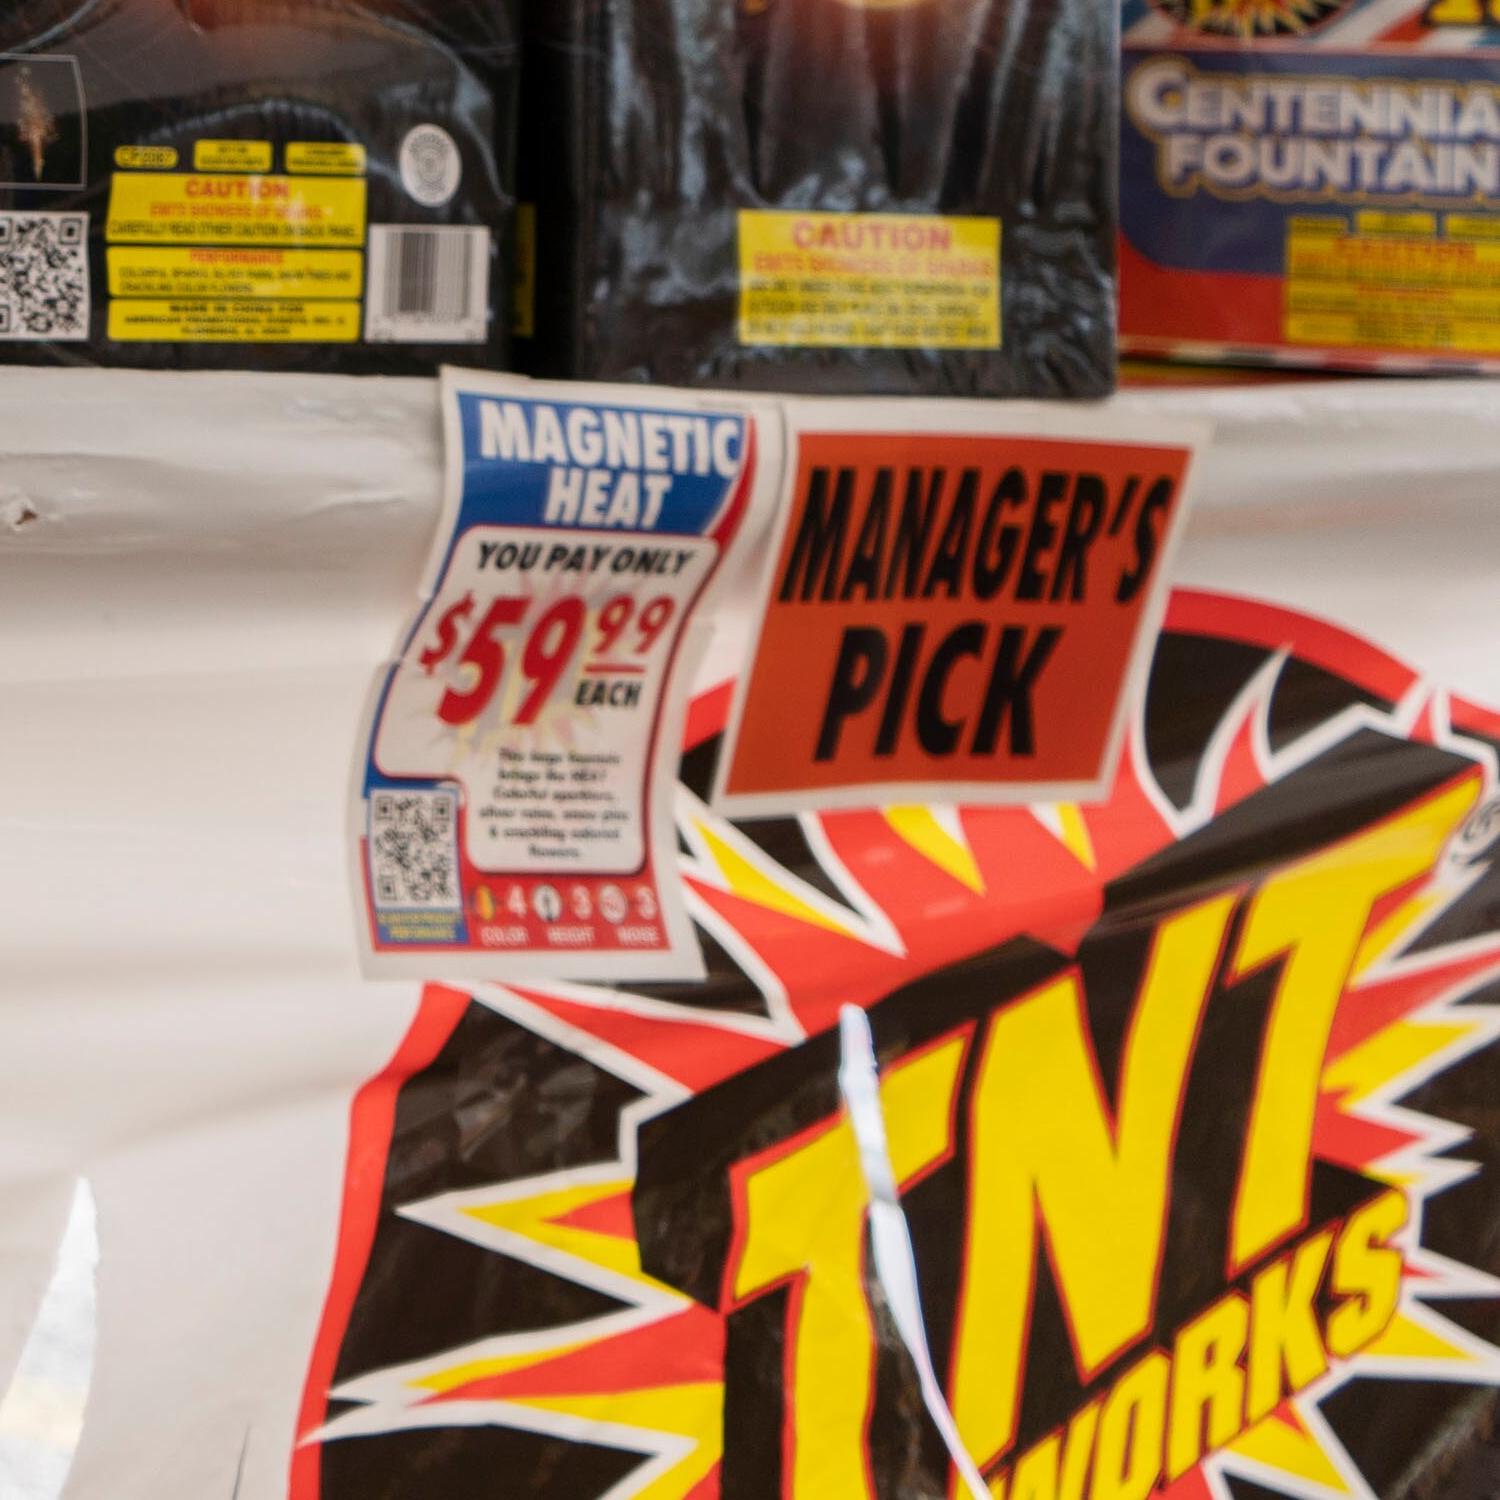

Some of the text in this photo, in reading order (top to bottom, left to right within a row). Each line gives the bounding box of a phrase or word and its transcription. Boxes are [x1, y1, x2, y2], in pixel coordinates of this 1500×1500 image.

[184, 178, 289, 198] CAUTION
[792, 218, 952, 251] CAUTION
[478, 399, 742, 481] MAGNETIC
[542, 466, 673, 531] HEAT
[475, 541, 697, 576] YOU PAY ONLY
[778, 465, 1175, 606] MANAGER'S
[574, 679, 642, 710] EACH
[812, 621, 1065, 764] PICK
